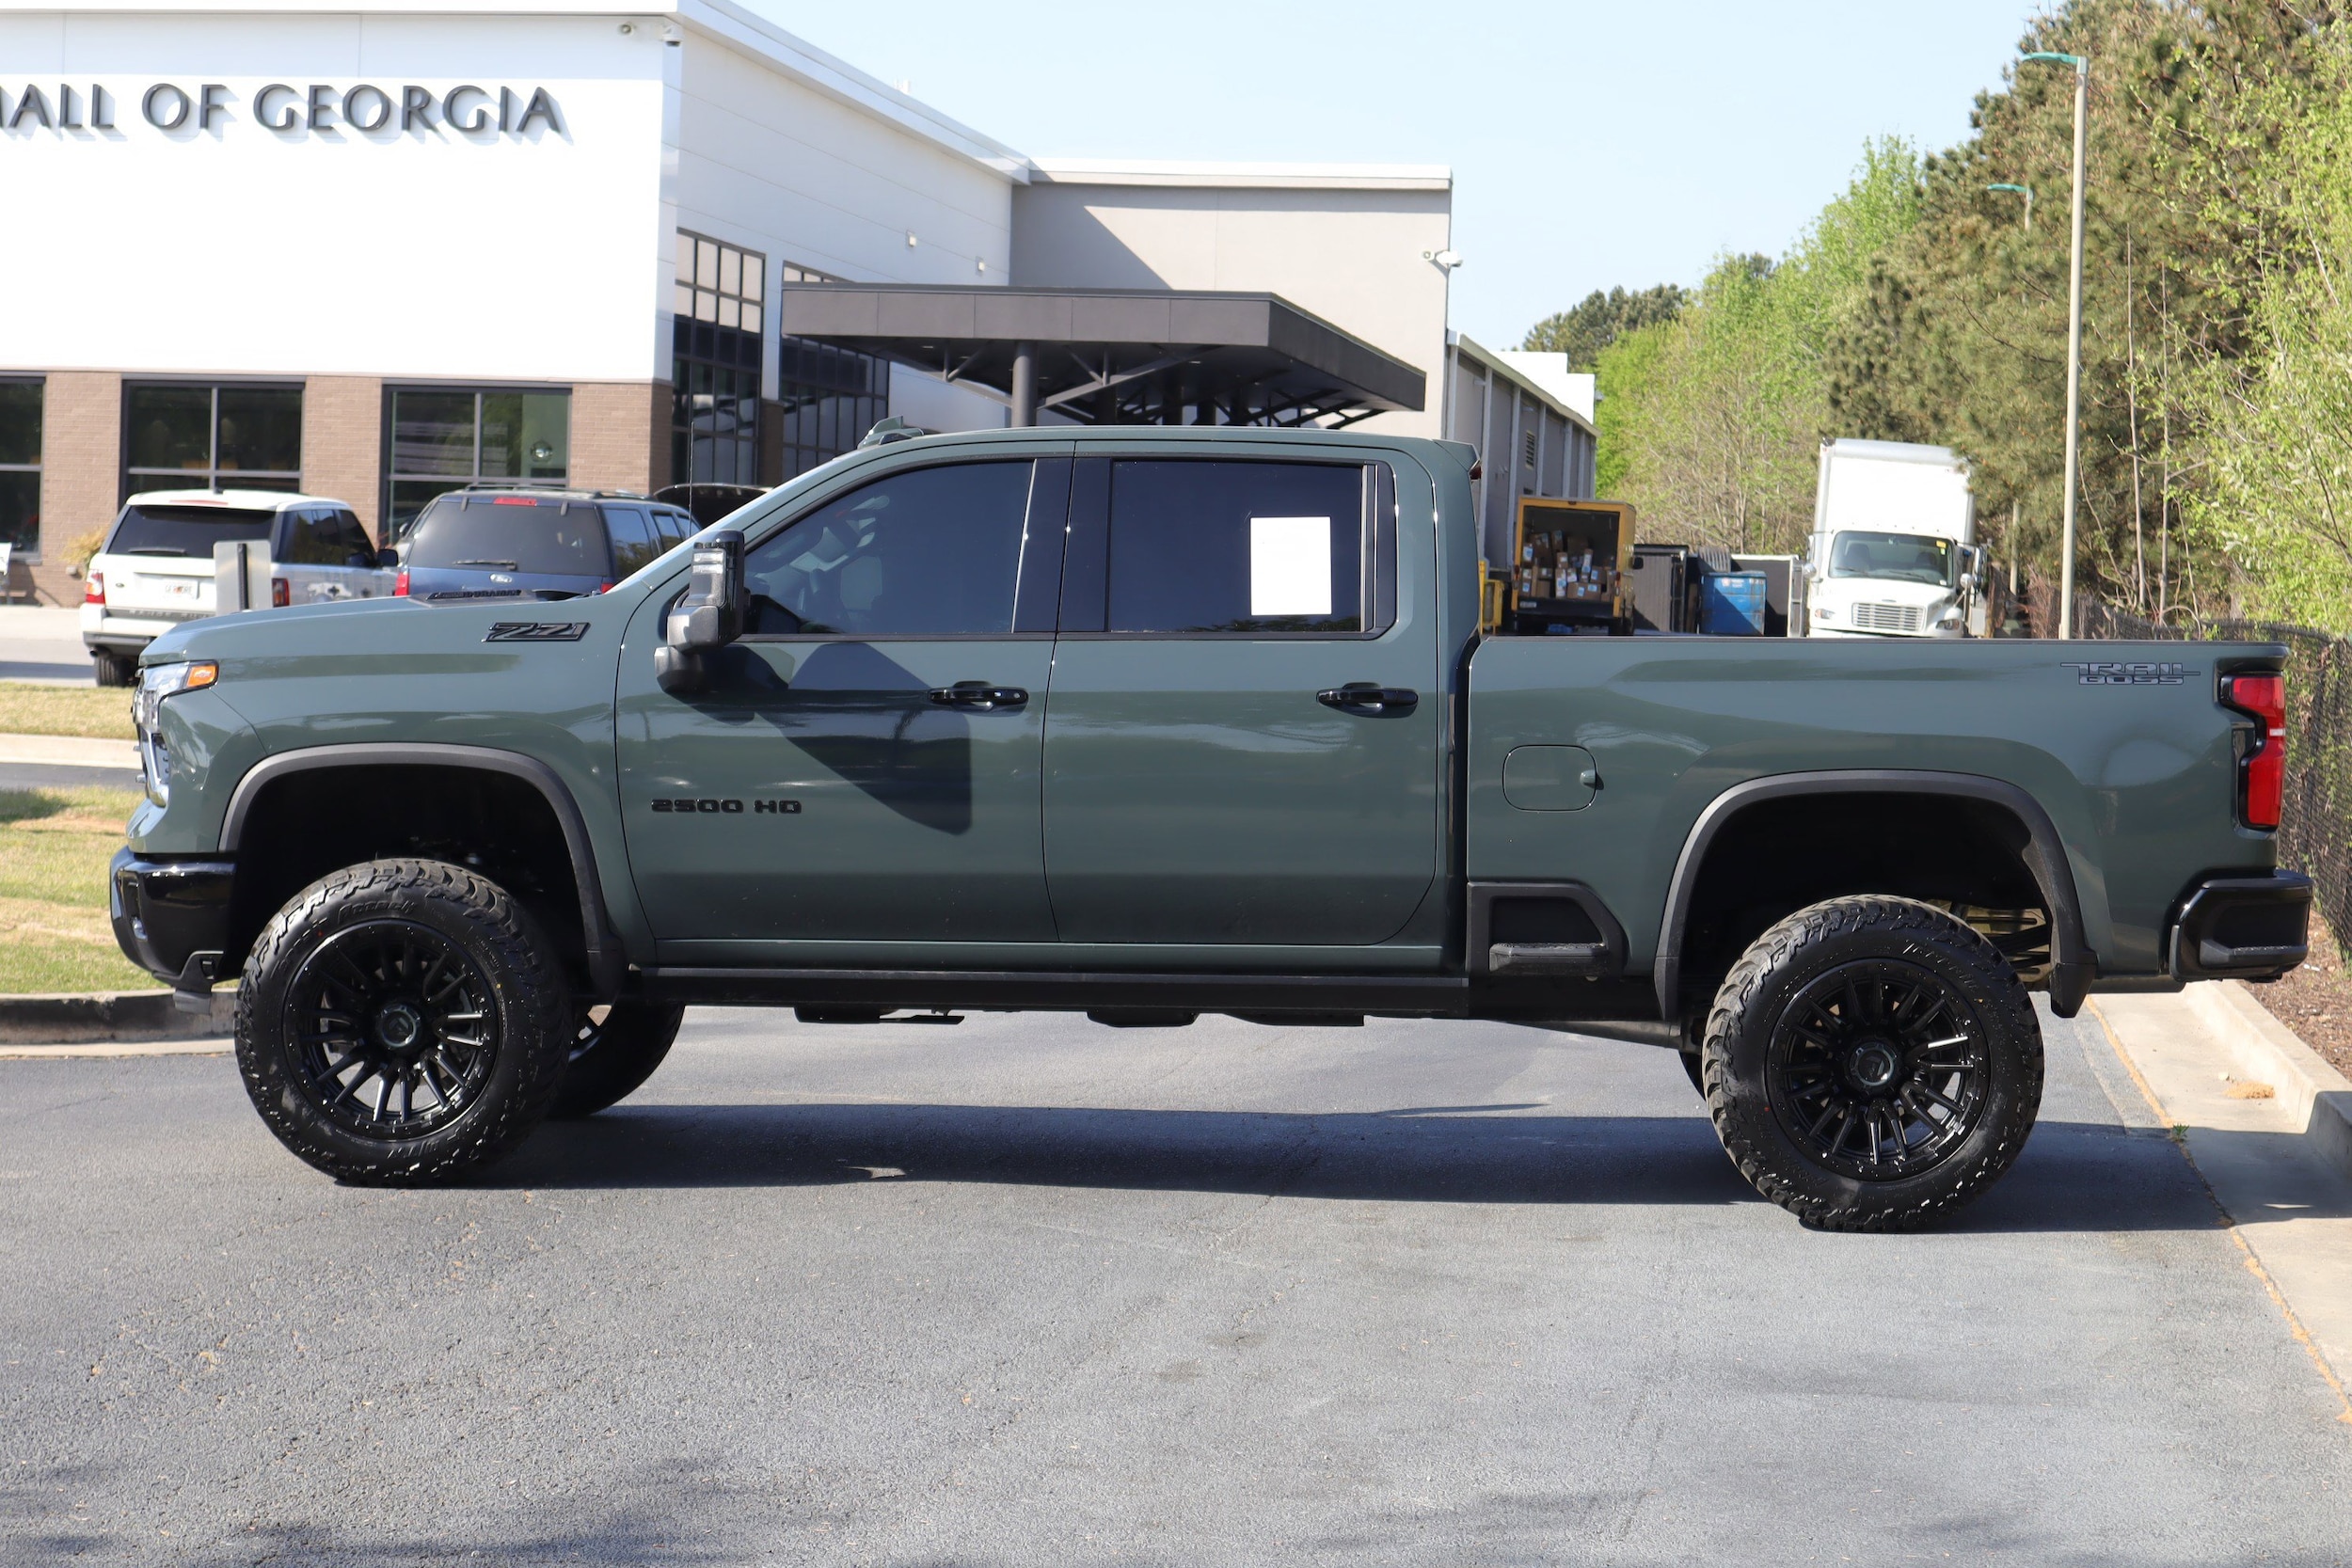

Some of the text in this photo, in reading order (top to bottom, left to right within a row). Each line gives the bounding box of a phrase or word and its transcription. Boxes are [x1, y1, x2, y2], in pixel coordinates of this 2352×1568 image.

[0, 83, 562, 134] ALL OF GEORGIA
[485, 622, 591, 641] Z71
[2060, 662, 2201, 675] TRAIL
[2078, 675, 2185, 685] BOSS
[651, 799, 803, 814] 2500 HD
